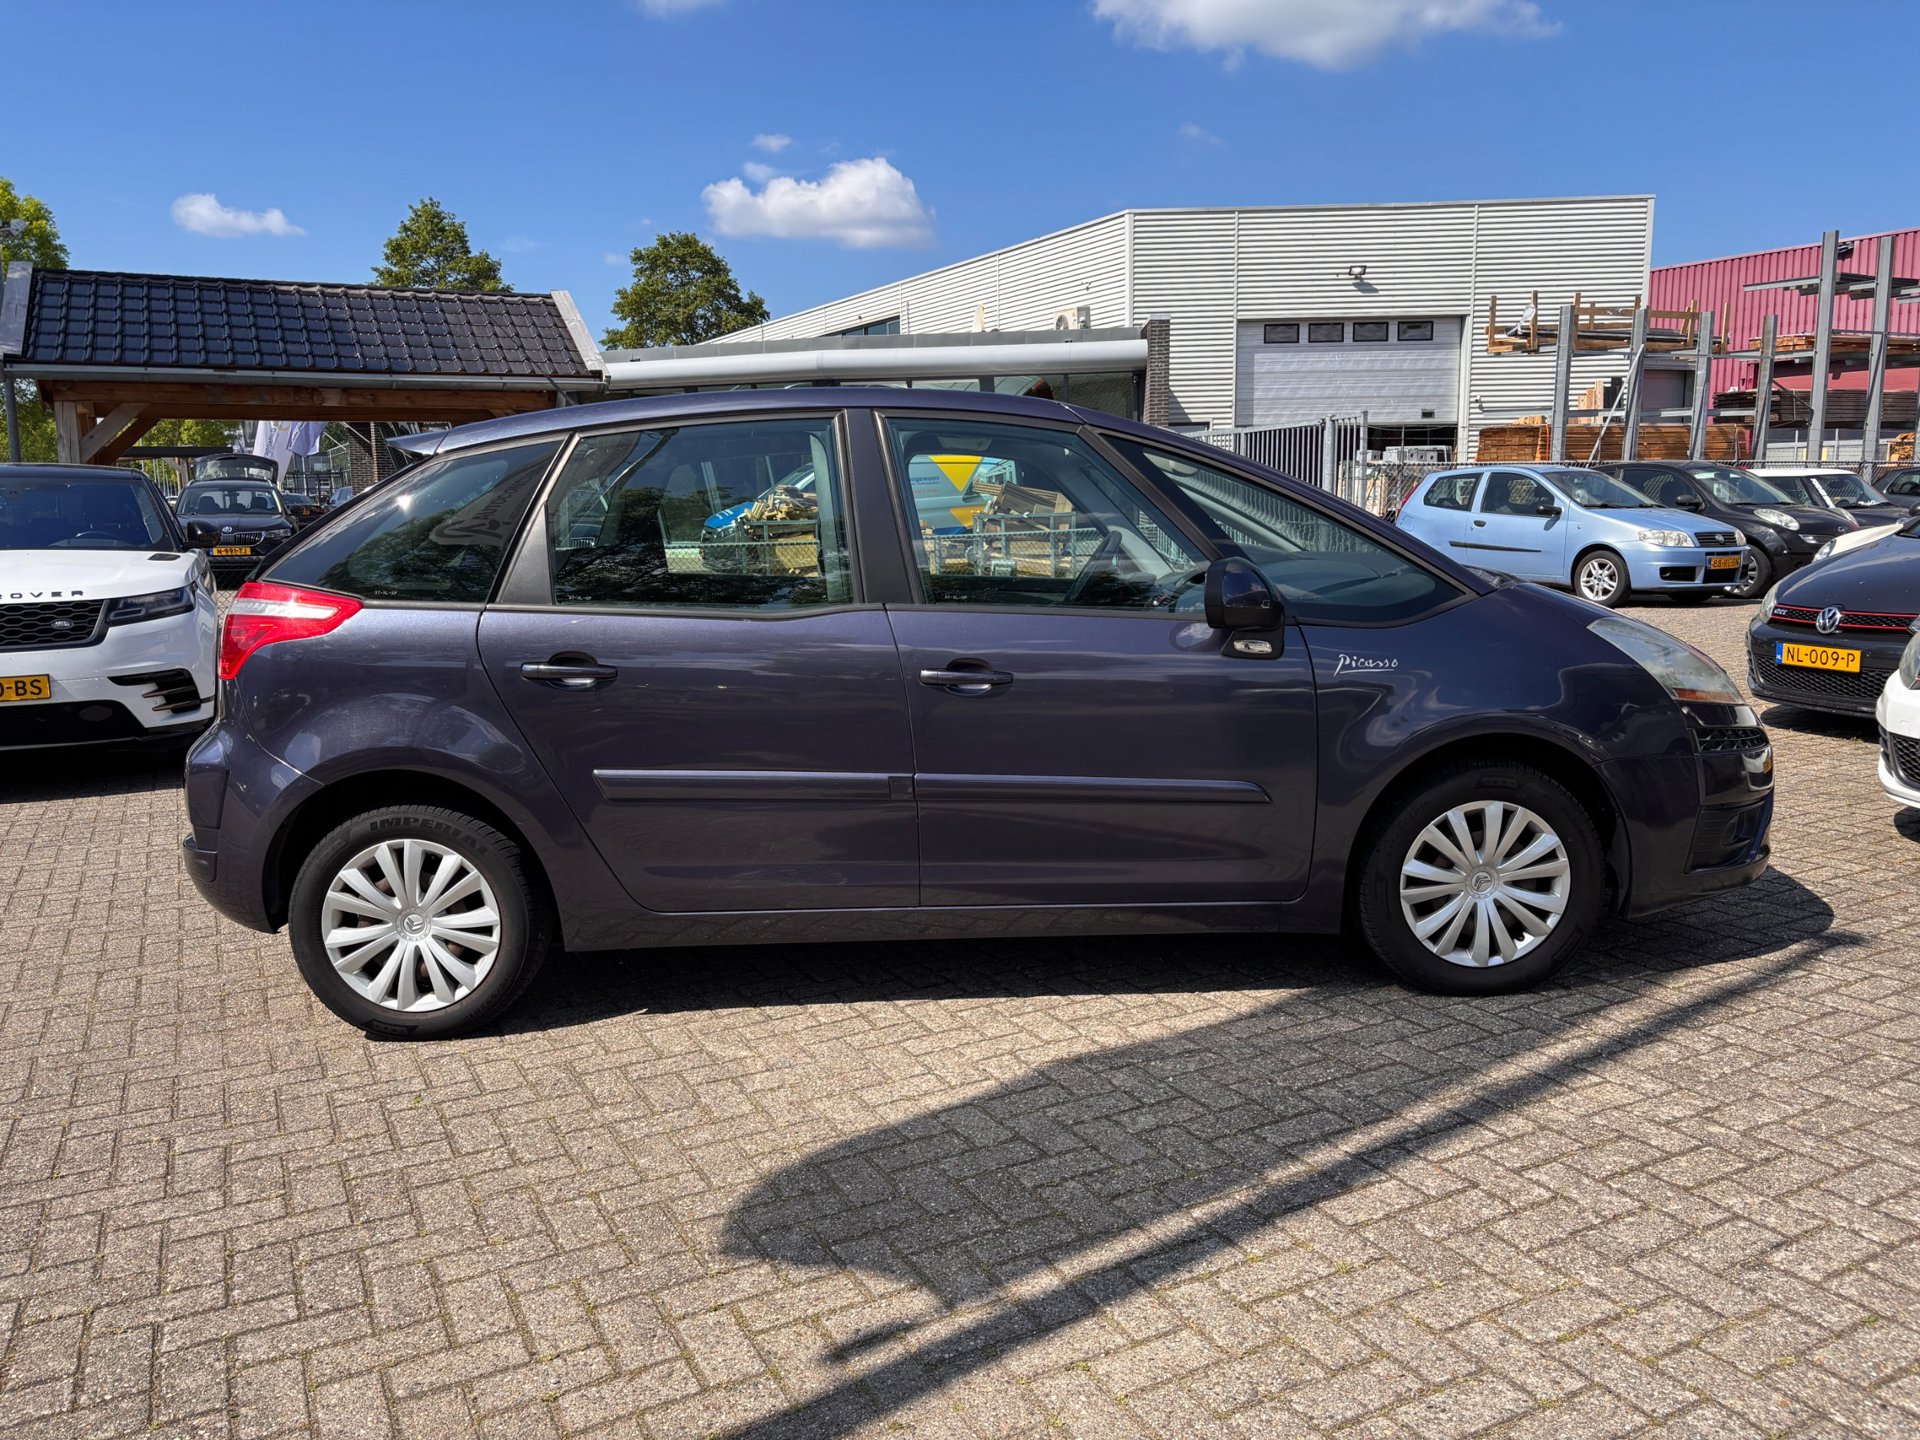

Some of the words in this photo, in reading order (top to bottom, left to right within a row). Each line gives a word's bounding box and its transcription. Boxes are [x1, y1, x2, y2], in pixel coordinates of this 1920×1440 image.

[1333, 653, 1399, 677] Picasso
[1786, 646, 1856, 668] NL-009-P
[369, 815, 488, 853] IMPERIAL
